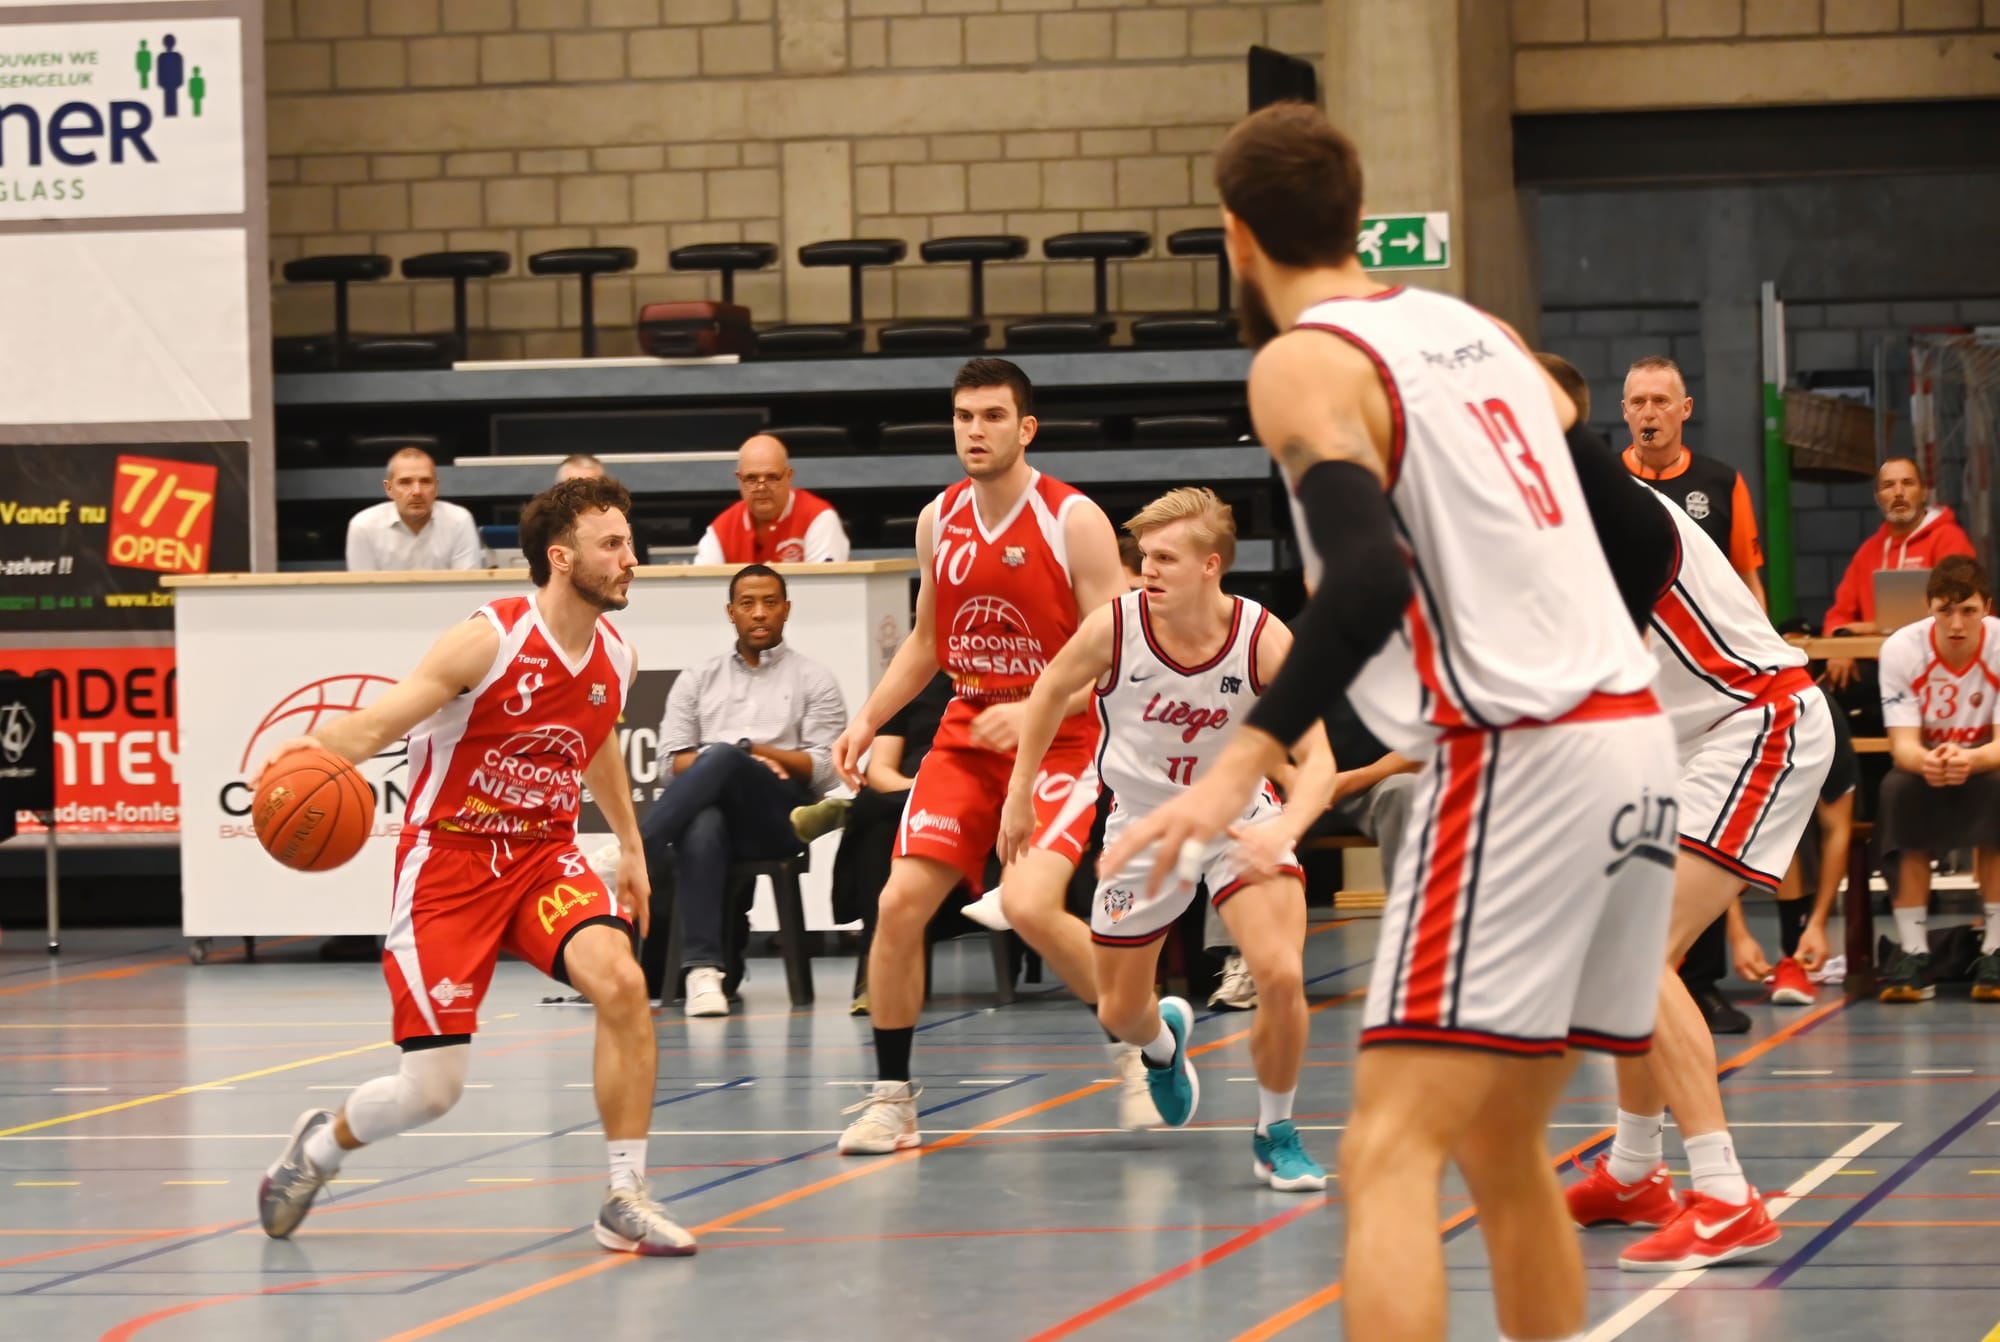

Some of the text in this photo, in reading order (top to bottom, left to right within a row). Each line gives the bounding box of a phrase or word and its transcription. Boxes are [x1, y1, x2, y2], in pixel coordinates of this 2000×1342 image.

[68, 51, 98, 65] WE
[1465, 398, 1562, 529] 13
[0, 500, 107, 525] Vanaf nu
[119, 463, 212, 538] 7/7
[111, 534, 202, 571] OPEN
[934, 539, 977, 585] 10
[948, 634, 1041, 653] CROONEN
[504, 672, 544, 717] 8
[1921, 683, 1958, 719] 13
[1142, 692, 1229, 743] Liège
[556, 852, 585, 878] 8
